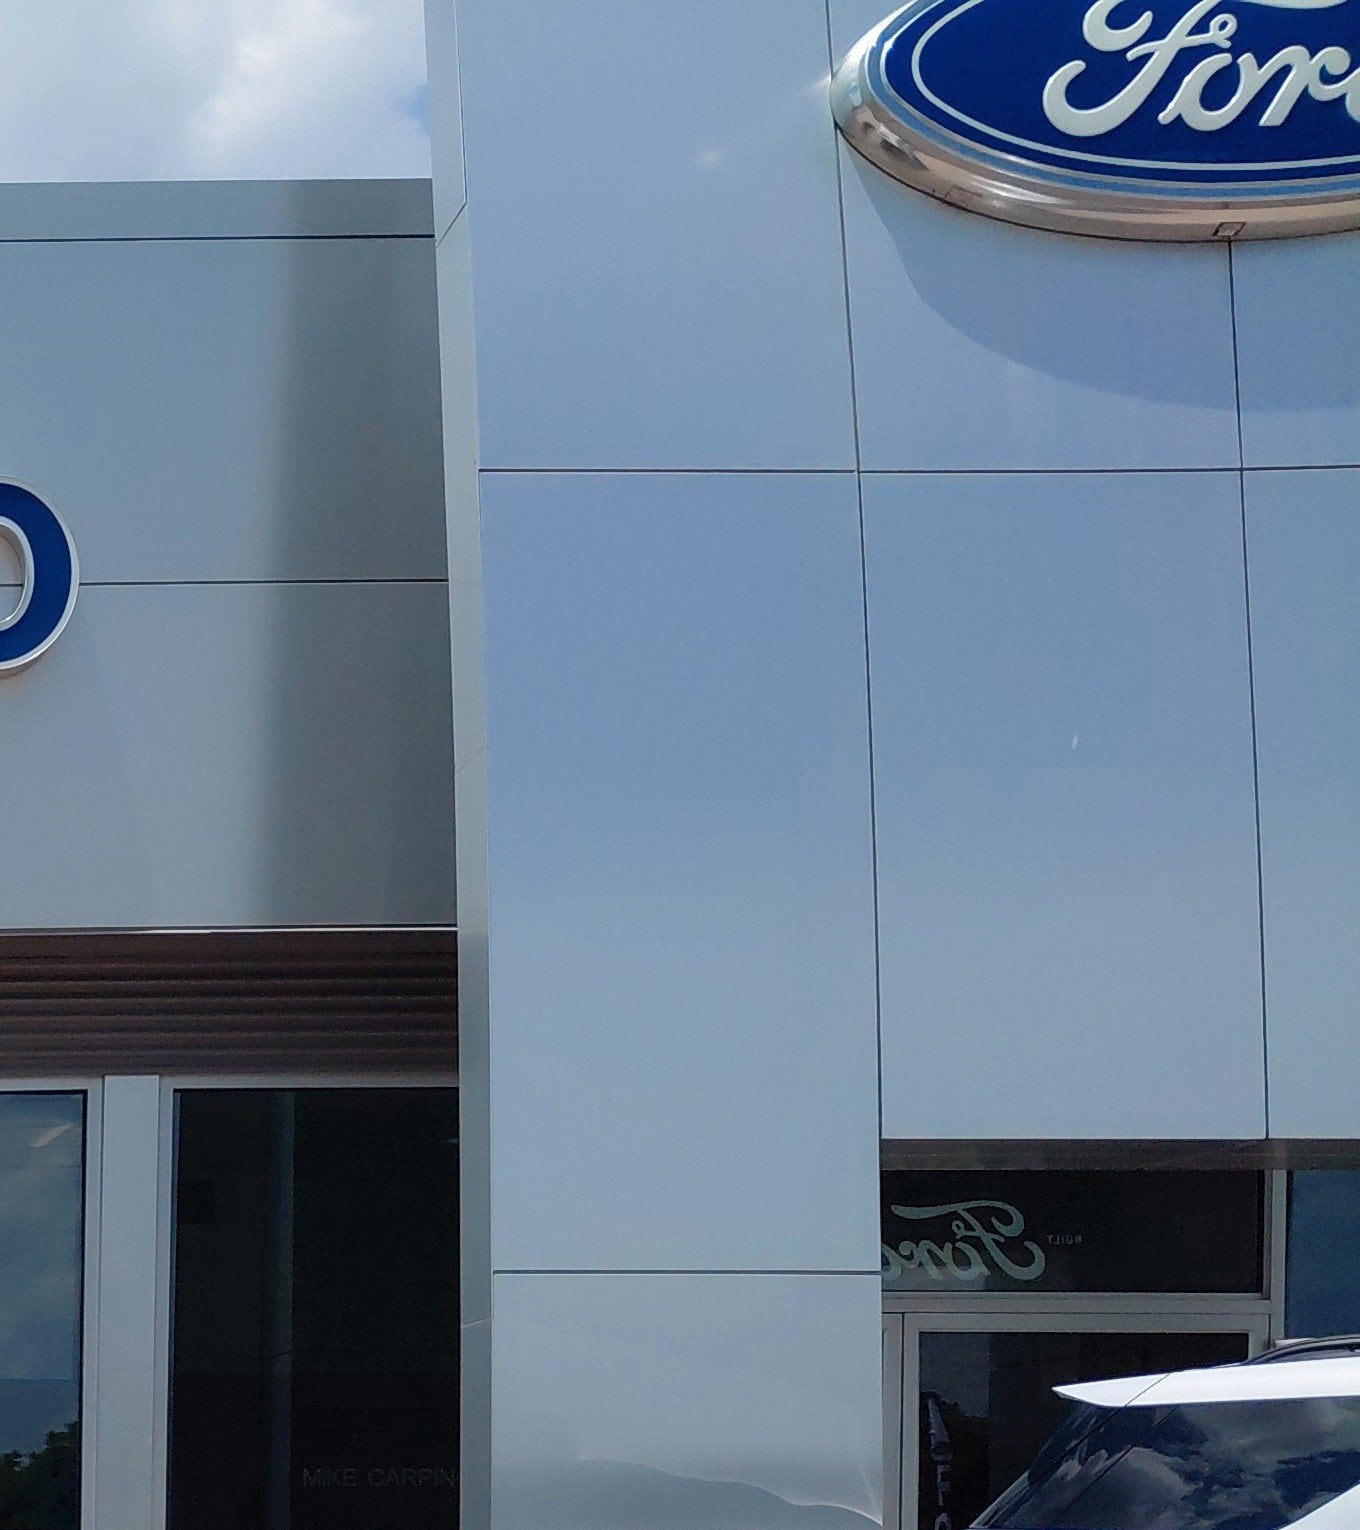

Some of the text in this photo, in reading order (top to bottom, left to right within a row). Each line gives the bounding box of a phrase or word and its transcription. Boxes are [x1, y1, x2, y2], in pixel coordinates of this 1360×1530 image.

[1043, 0, 1360, 136] For
[302, 1467, 459, 1488] MIKE CARPIN
